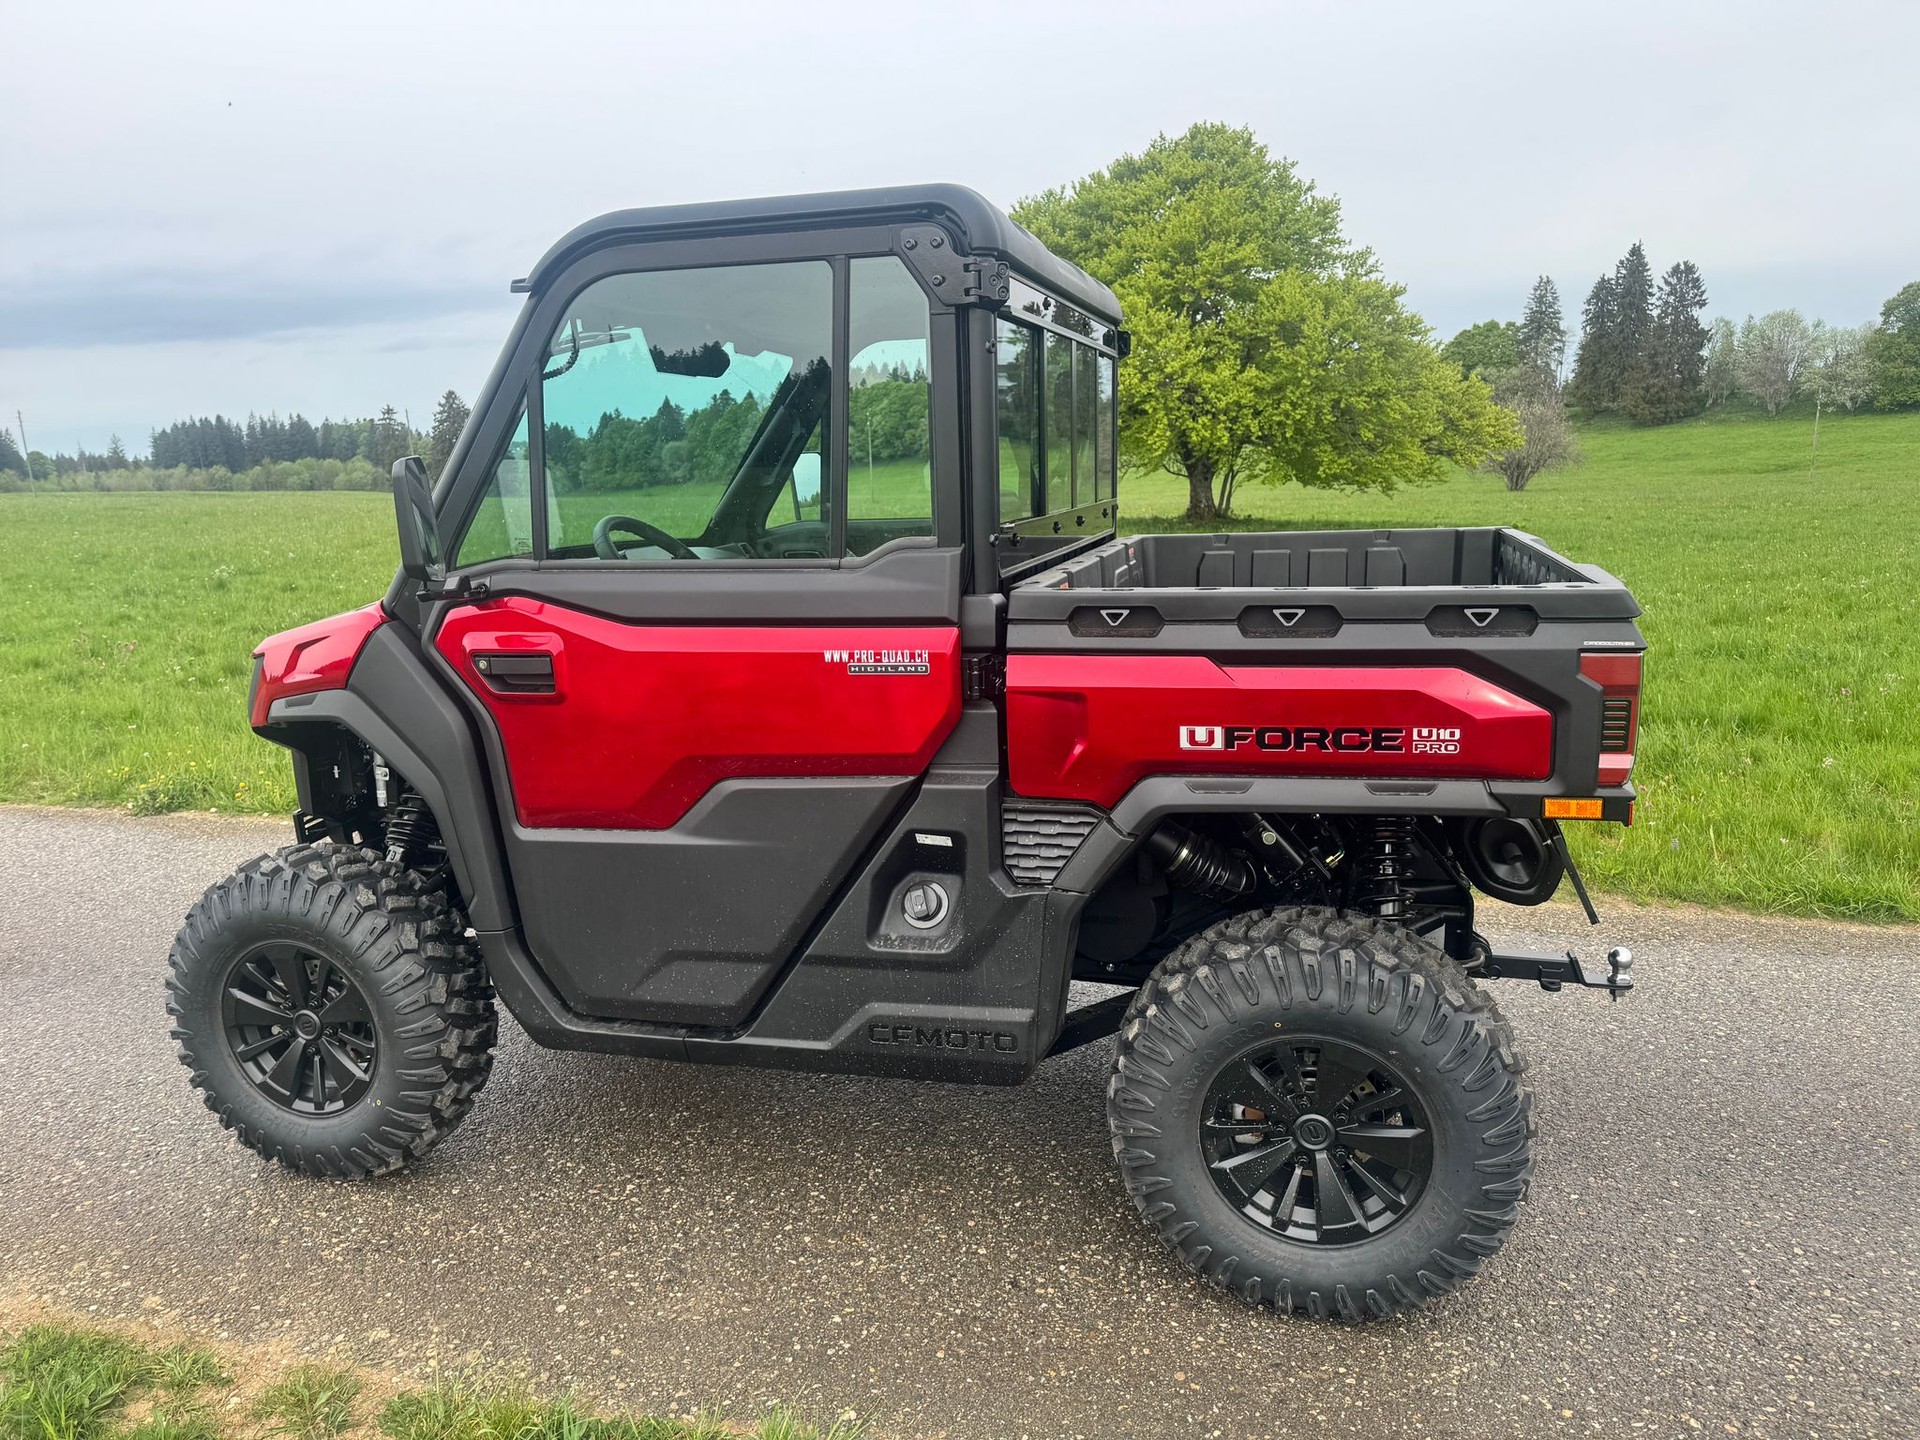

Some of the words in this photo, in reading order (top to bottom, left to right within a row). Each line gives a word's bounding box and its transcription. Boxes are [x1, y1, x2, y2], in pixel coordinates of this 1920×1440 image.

[823, 649, 929, 663] WWW.PRO-QUAD.CH
[850, 665, 926, 673] HIGHLAND
[1412, 727, 1461, 741] U10
[1412, 741, 1461, 755] PRO
[867, 1023, 1019, 1054] CFMOTO
